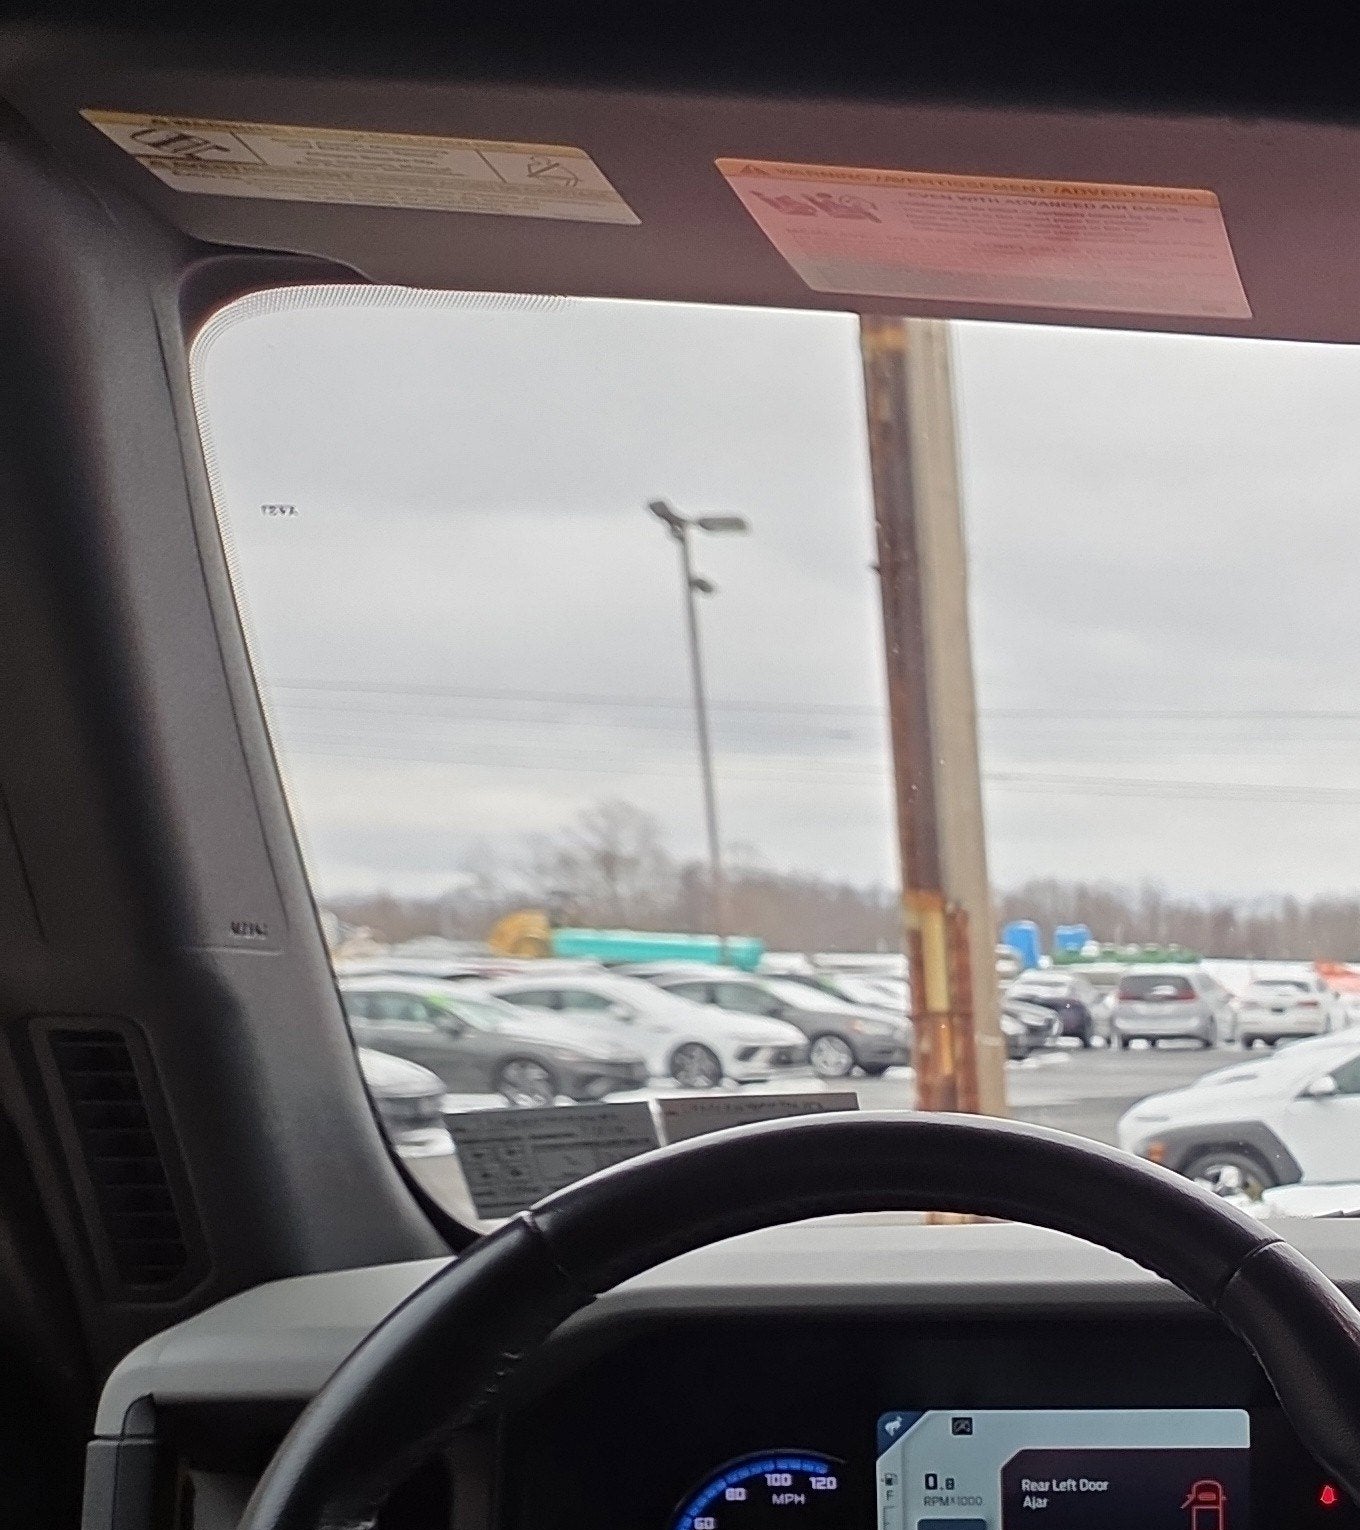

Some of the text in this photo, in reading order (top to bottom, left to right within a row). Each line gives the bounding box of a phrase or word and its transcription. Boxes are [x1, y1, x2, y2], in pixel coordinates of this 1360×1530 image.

[765, 1473, 793, 1487] 100
[809, 1476, 838, 1490] 120
[1021, 1478, 1109, 1492] Rear Left Door
[725, 1487, 747, 1501] 80
[772, 1493, 806, 1505] MPH
[1022, 1495, 1049, 1510] Ajar
